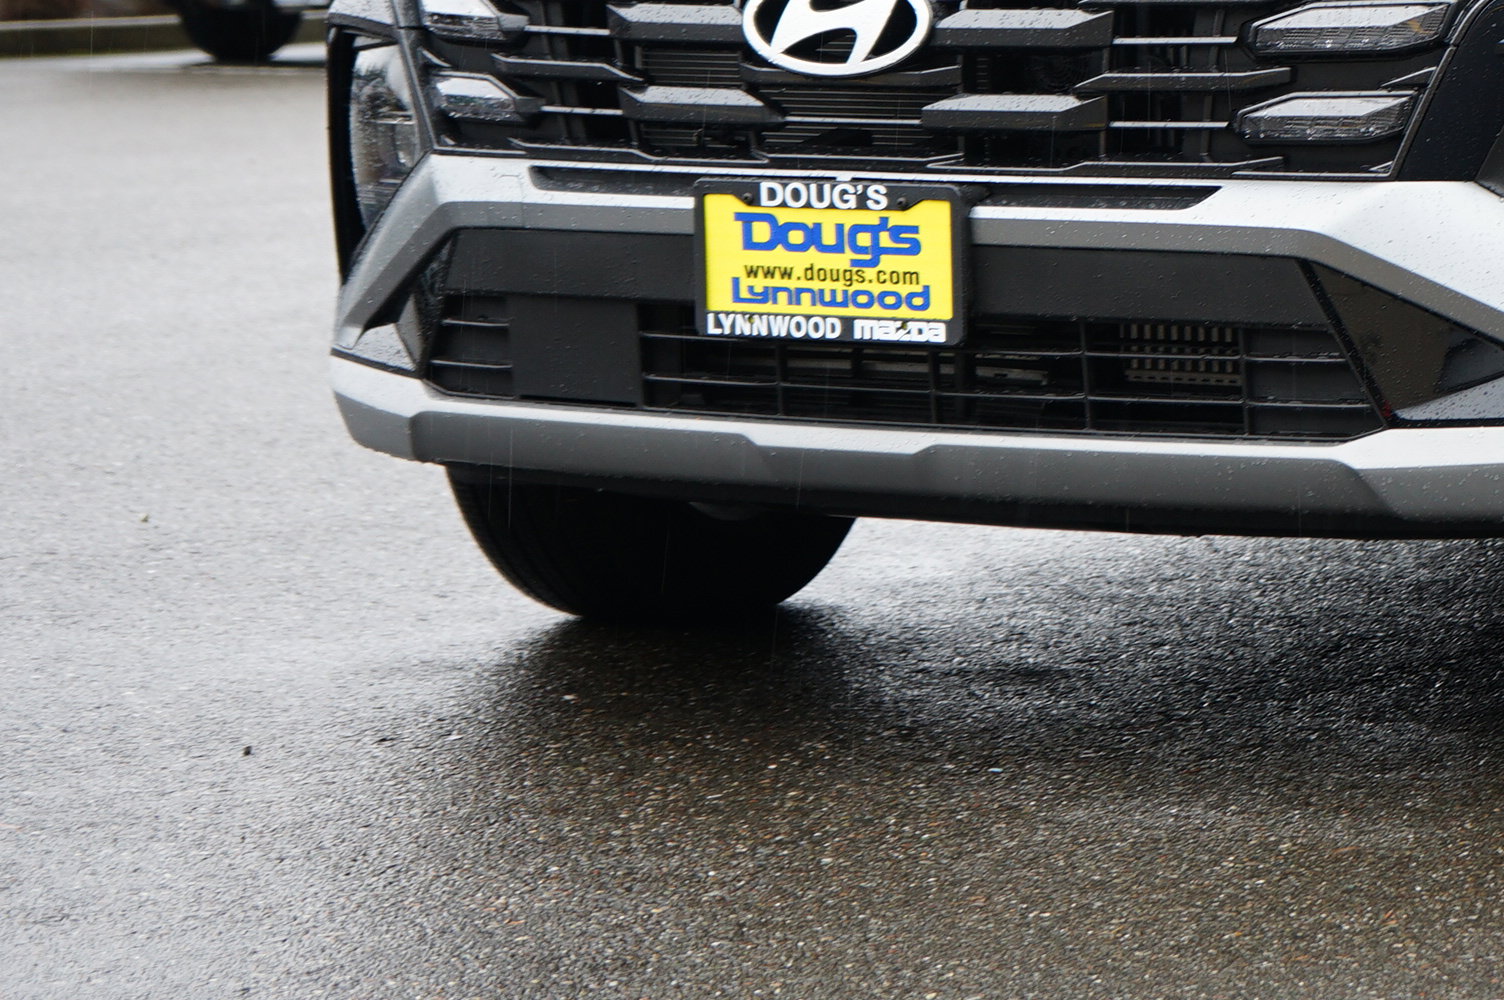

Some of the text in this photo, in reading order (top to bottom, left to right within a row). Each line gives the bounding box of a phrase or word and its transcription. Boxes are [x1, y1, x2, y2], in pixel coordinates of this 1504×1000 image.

[760, 181, 888, 210] DOUG'S
[734, 211, 922, 268] Doug's
[744, 263, 920, 287] www.dougs.com
[732, 277, 931, 311] Lynnwood
[706, 312, 842, 340] LYNNWOOD
